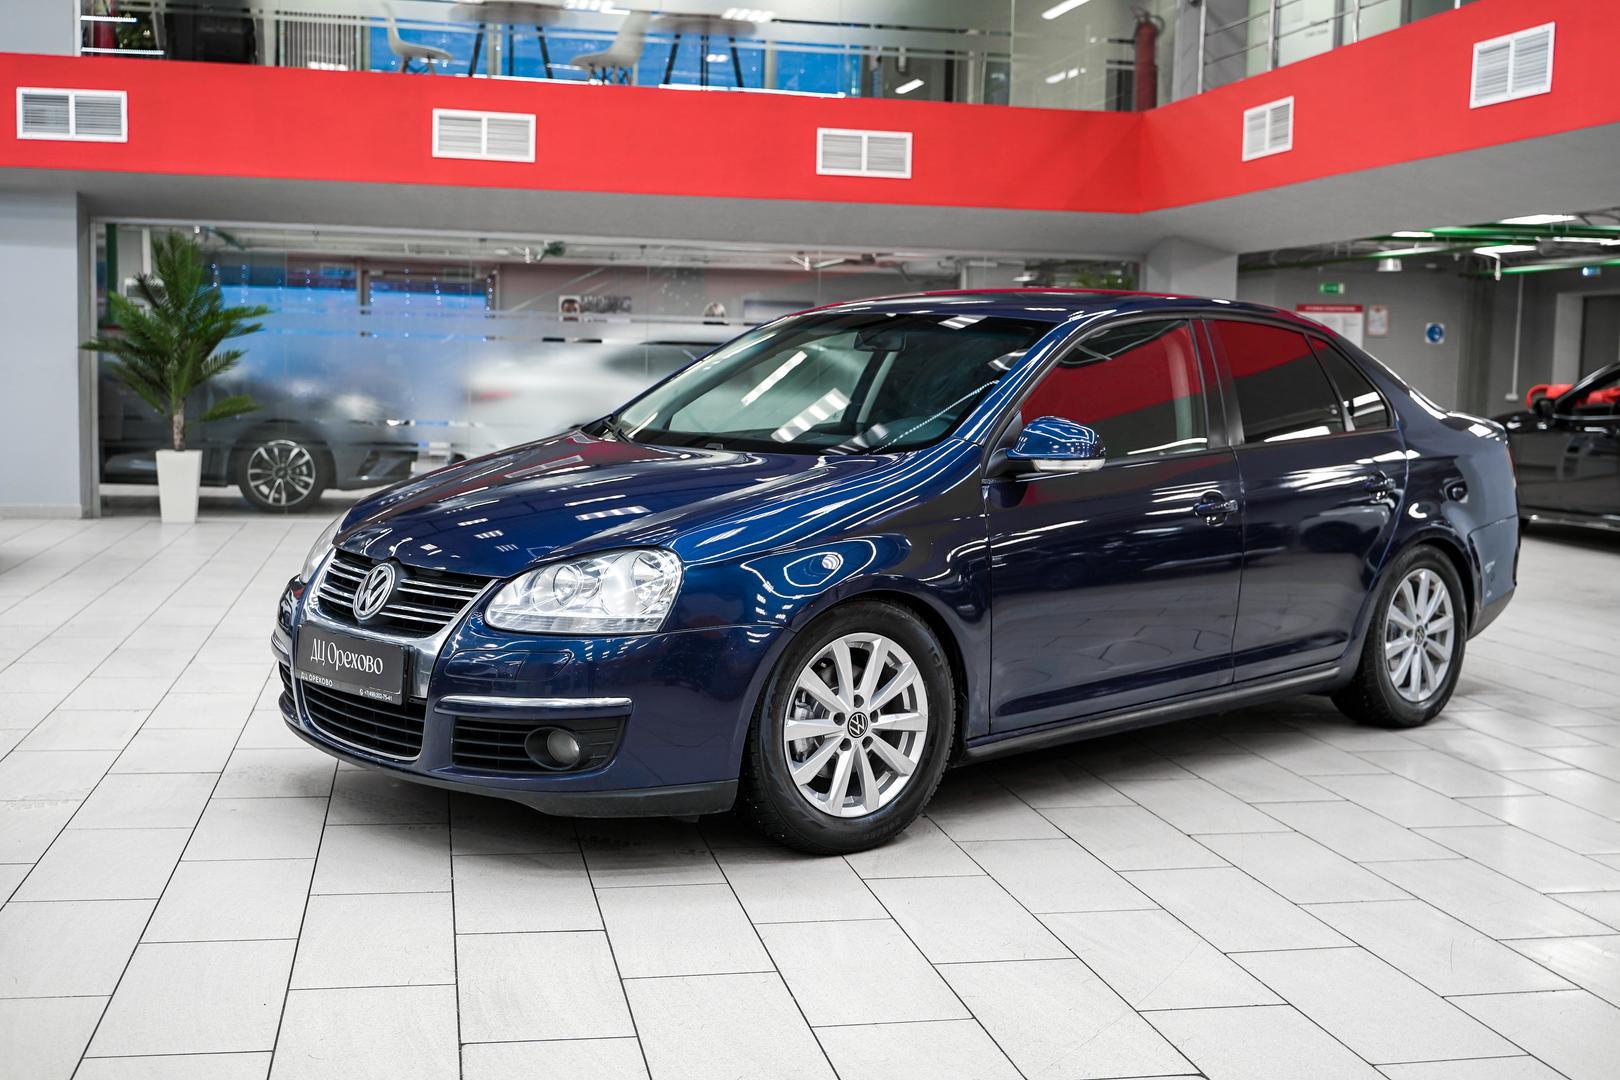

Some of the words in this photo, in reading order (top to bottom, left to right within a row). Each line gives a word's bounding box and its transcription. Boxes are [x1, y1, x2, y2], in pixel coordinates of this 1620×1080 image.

[310, 638, 326, 666] ДЦ
[327, 642, 383, 674] Орехово
[309, 674, 333, 687] ОРЕХОВО
